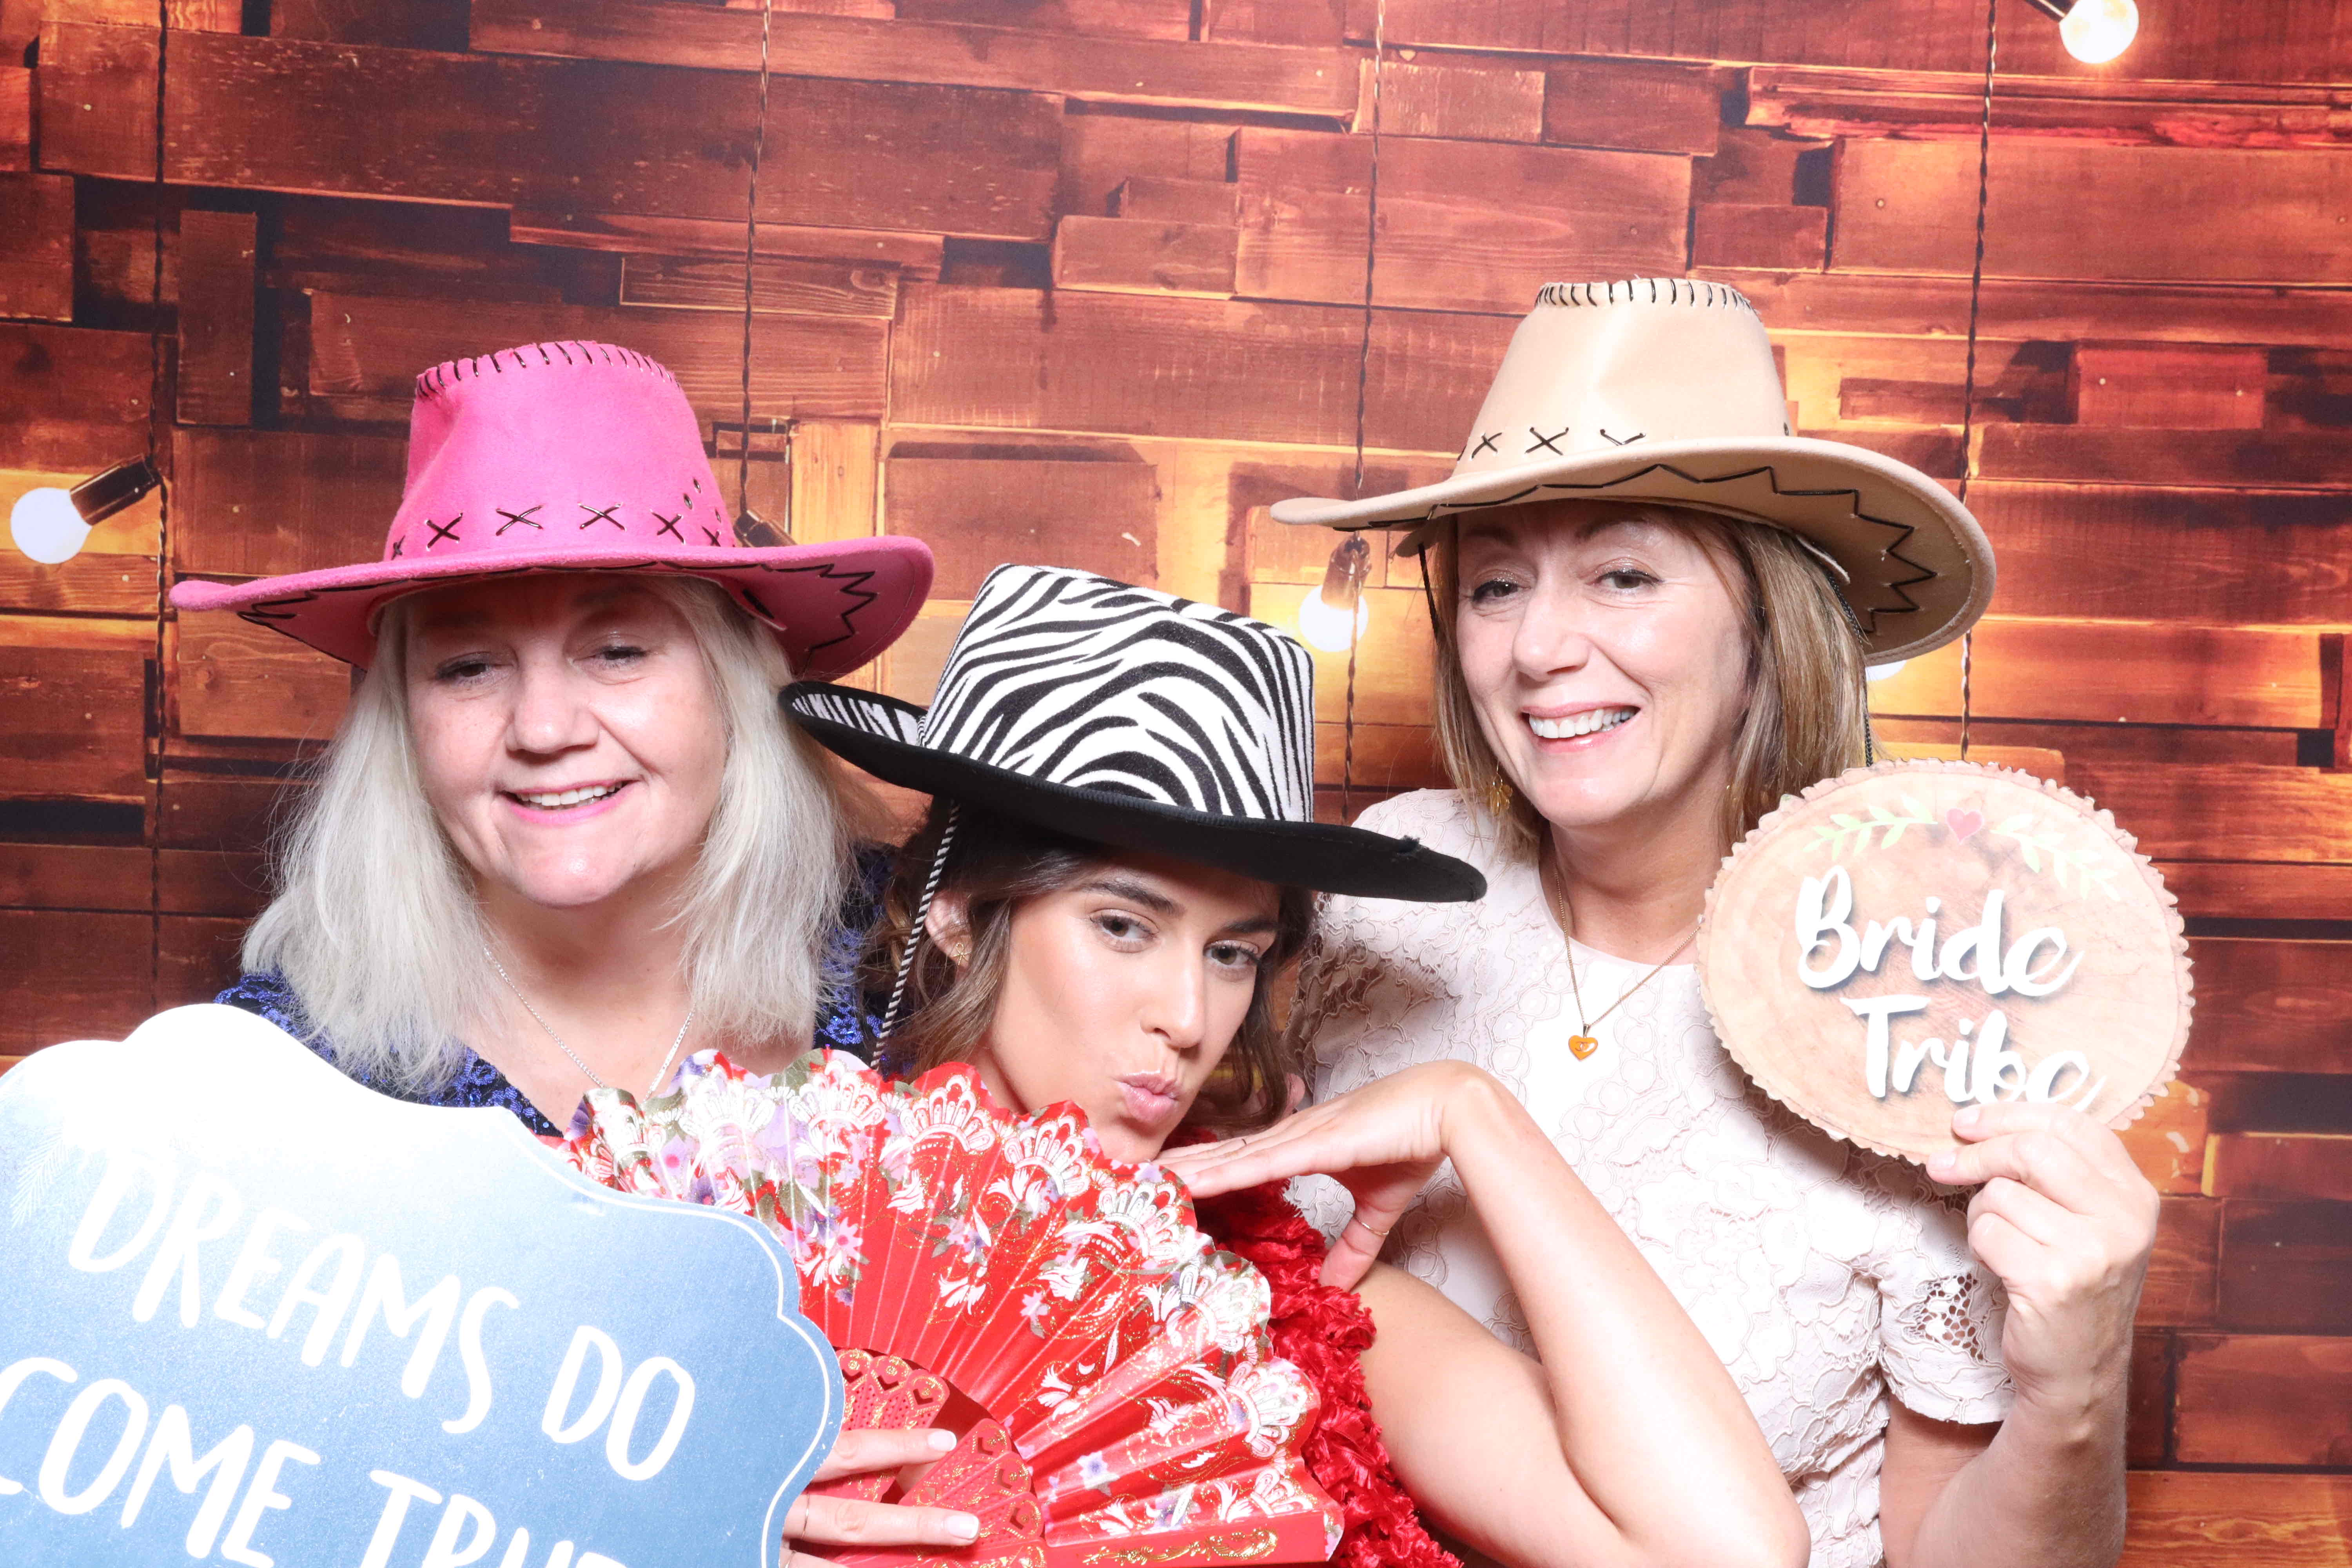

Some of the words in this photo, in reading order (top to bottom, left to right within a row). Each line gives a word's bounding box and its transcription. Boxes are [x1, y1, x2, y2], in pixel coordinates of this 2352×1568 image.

[1795, 866, 2084, 996] Bride
[1839, 995, 2107, 1112] Tribe
[69, 1144, 519, 1434] DREAMS
[541, 1325, 695, 1481] DO
[0, 1357, 321, 1568] COME
